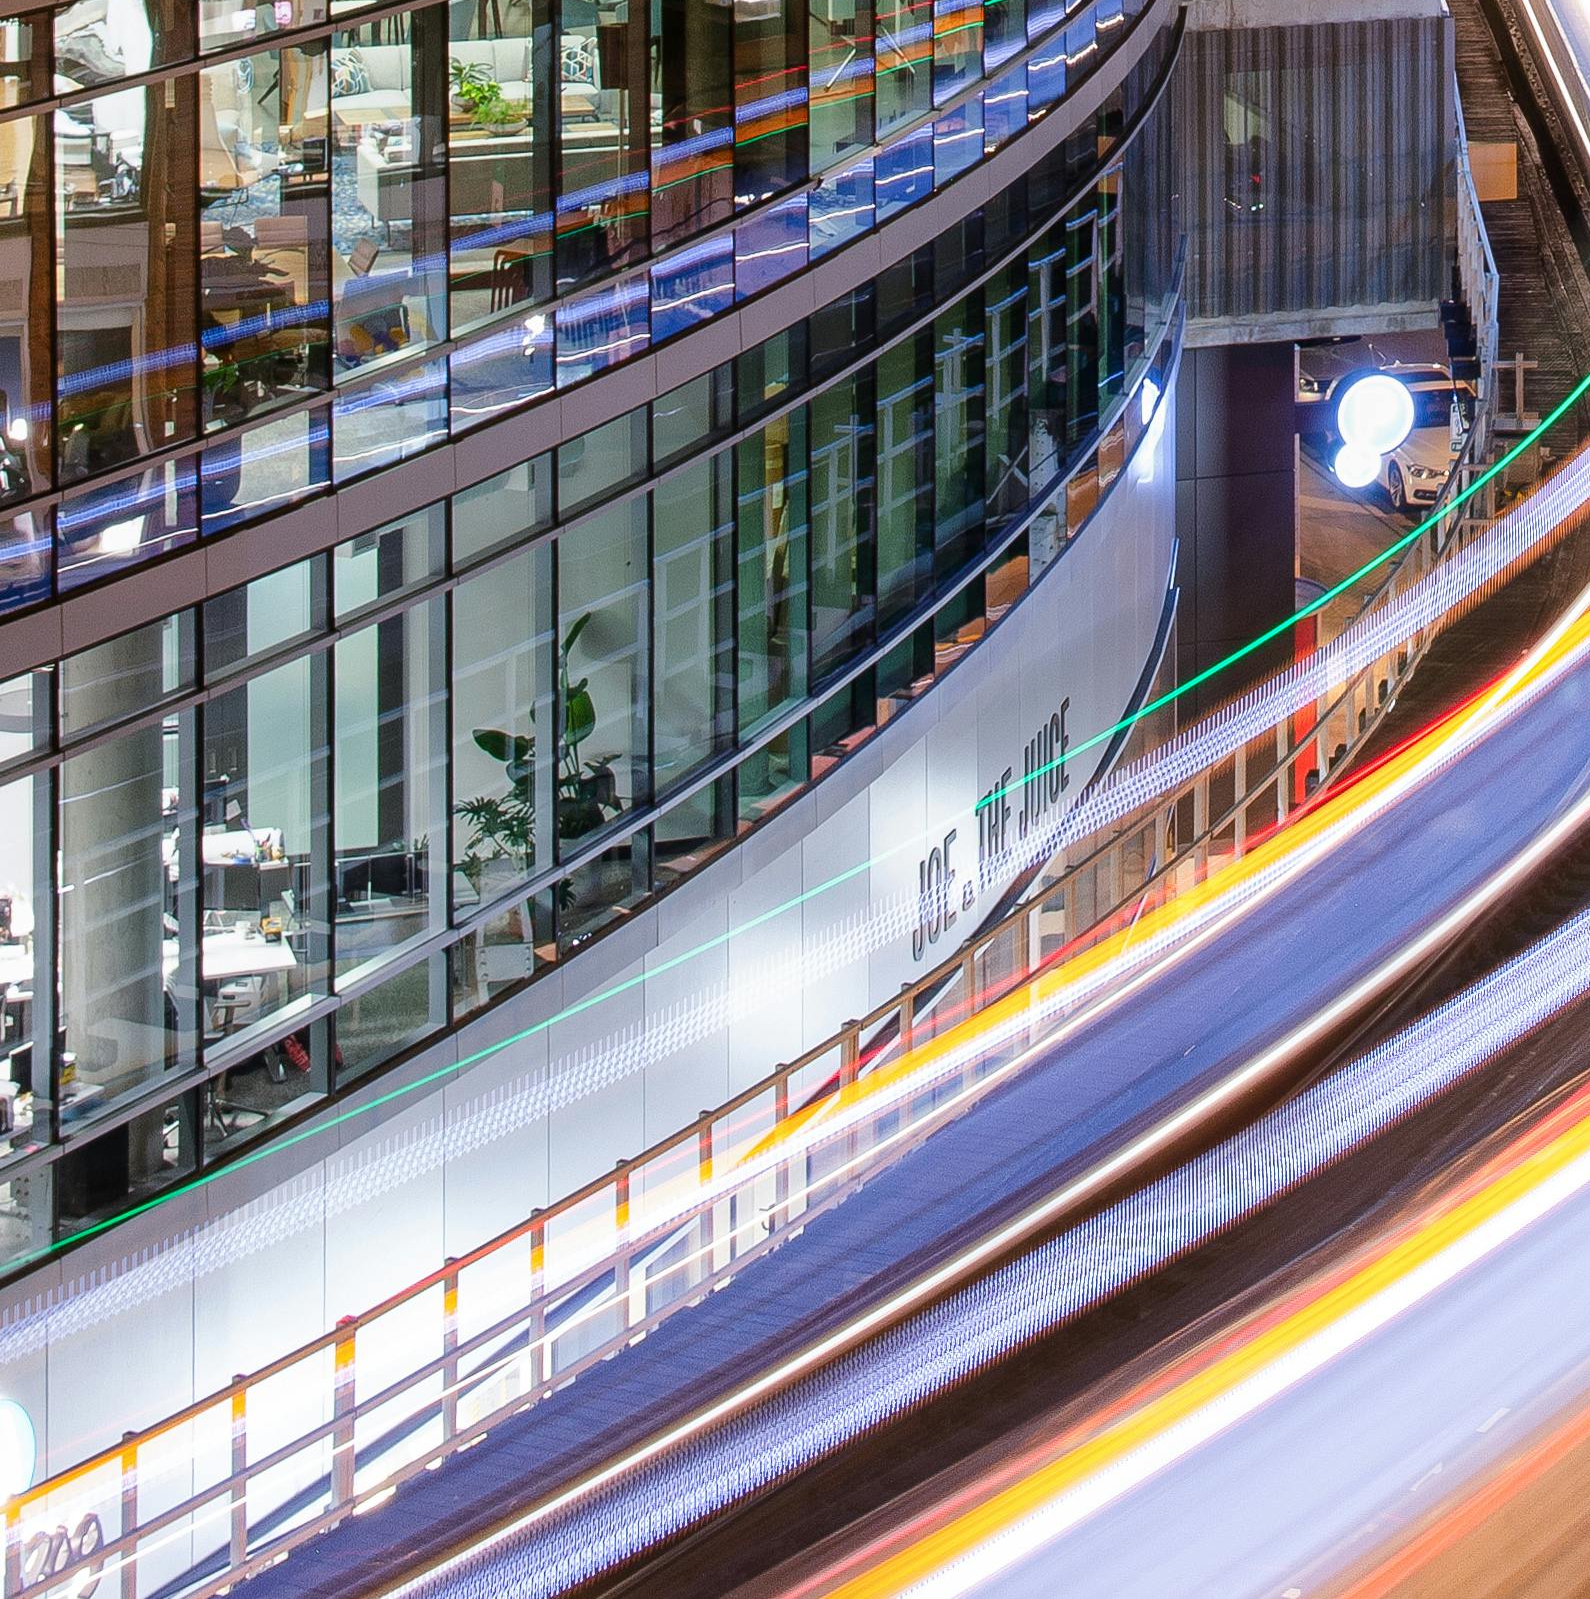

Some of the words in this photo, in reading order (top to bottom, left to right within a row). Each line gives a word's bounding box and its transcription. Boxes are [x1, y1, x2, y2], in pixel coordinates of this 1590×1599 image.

[912, 828, 957, 961] JOE
[975, 766, 1013, 891] THE
[1019, 696, 1070, 841] JUICE
